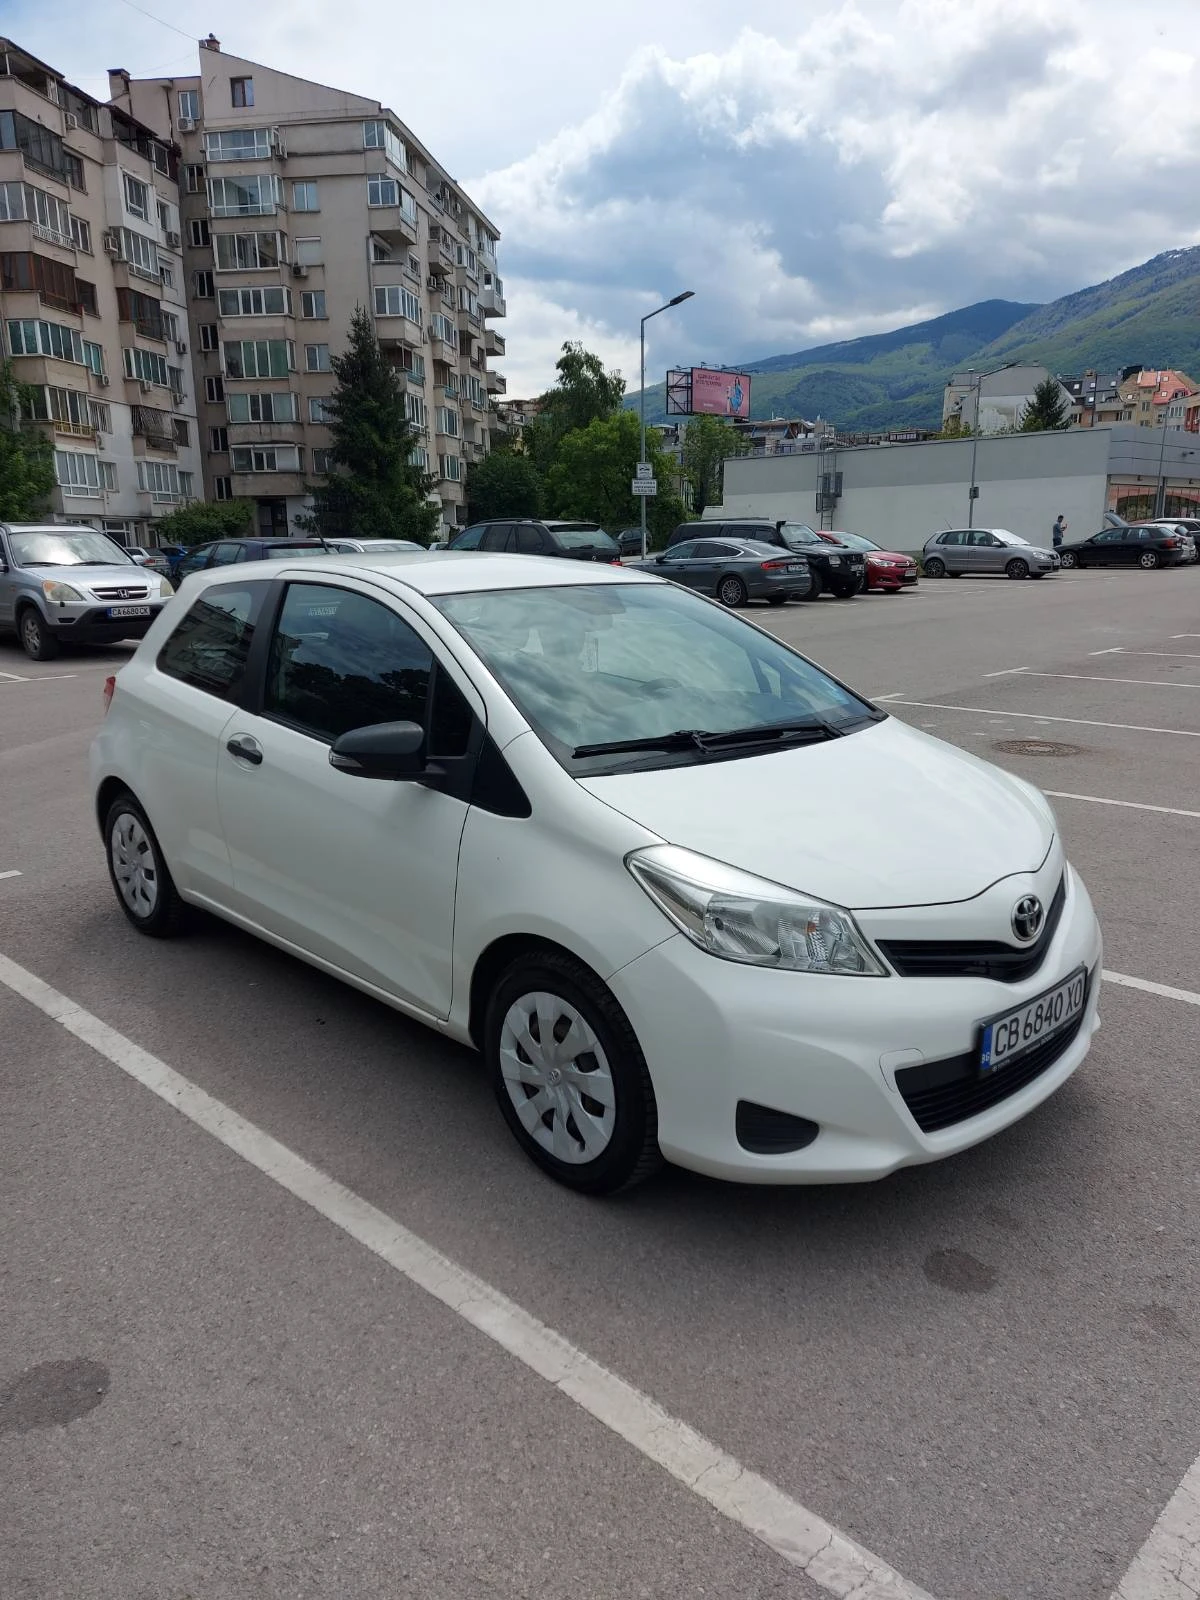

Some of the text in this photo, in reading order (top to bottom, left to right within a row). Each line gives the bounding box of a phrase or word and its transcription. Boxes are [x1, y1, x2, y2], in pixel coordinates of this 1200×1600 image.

[995, 1017, 1019, 1056] CB
[1023, 992, 1063, 1041] 6840
[1066, 978, 1082, 1017] XO
